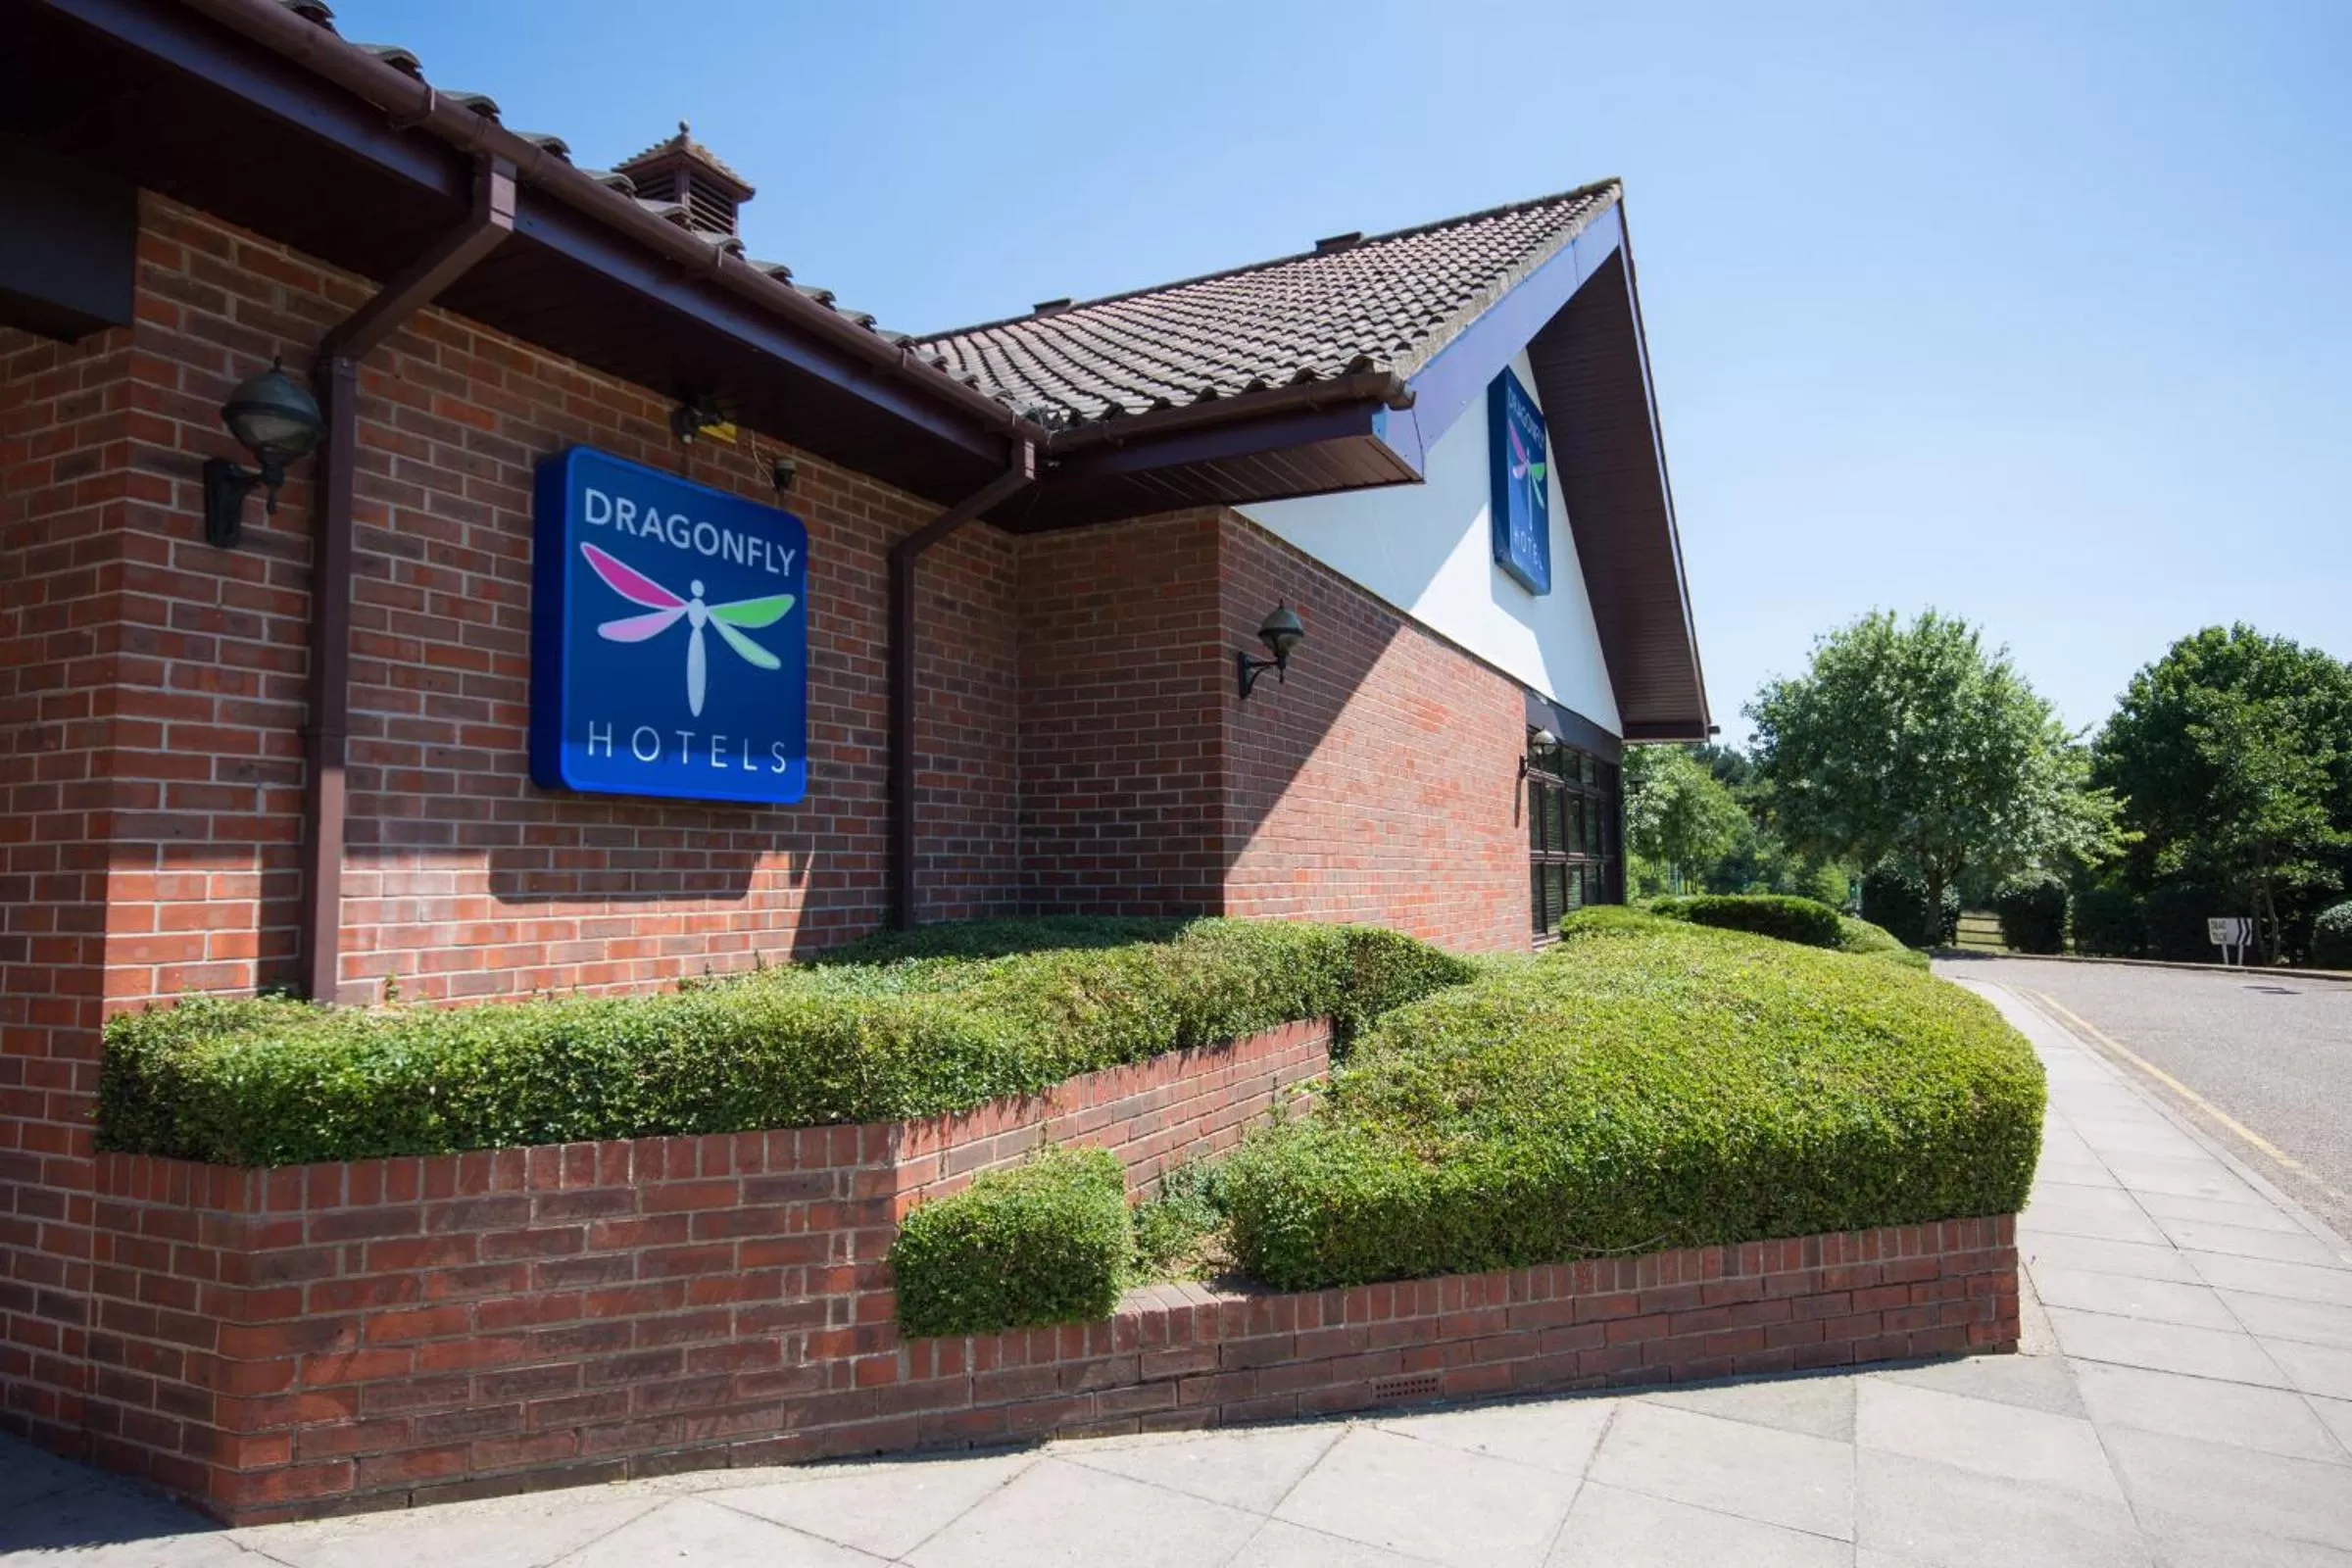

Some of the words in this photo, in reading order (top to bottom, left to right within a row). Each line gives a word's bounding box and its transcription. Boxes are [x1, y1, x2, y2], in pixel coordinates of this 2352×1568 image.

[1507, 386, 1545, 450] DRAGONFLY
[585, 487, 796, 576] DRAGONFLY
[588, 720, 787, 773] HOTELS
